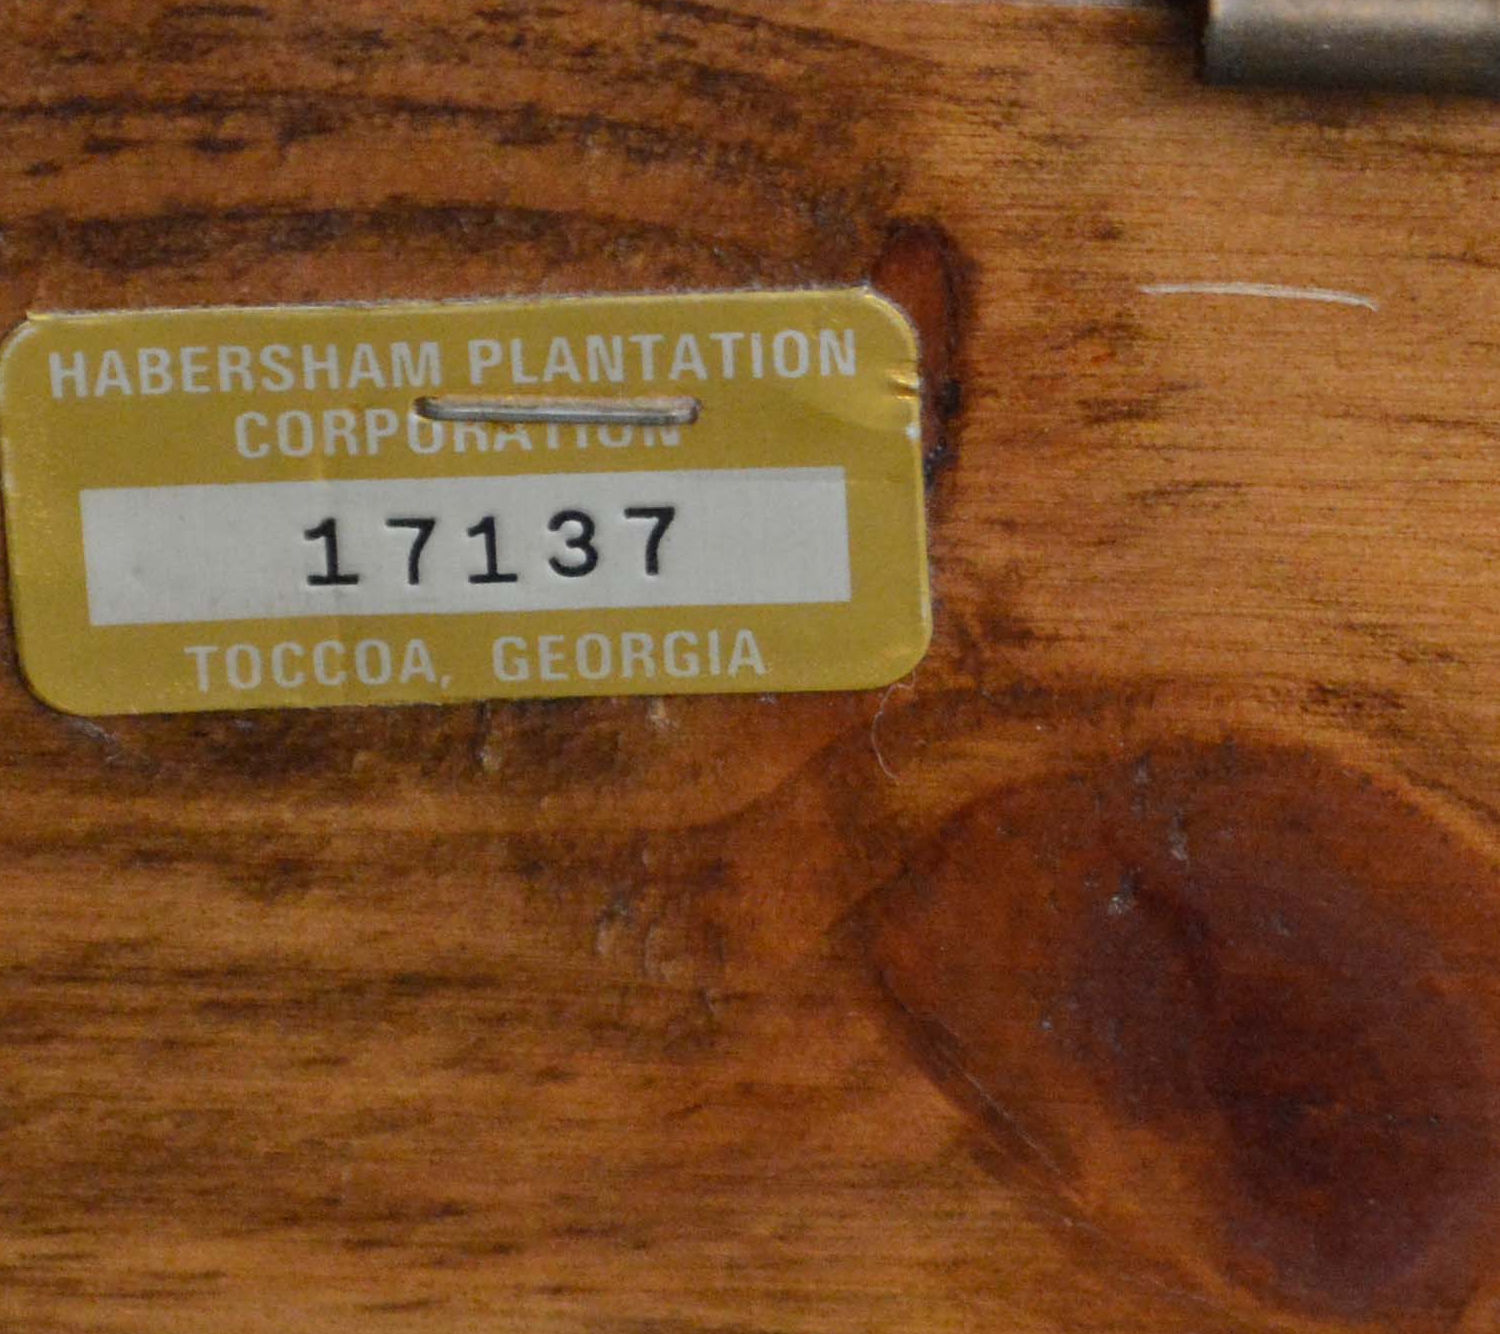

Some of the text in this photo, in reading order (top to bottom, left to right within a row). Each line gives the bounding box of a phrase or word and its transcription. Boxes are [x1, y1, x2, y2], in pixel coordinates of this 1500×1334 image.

[48, 329, 858, 399] HABERSHAM PLANTATION
[302, 506, 677, 587] 17137
[184, 628, 766, 691] TOCCOA, GEORGIA
